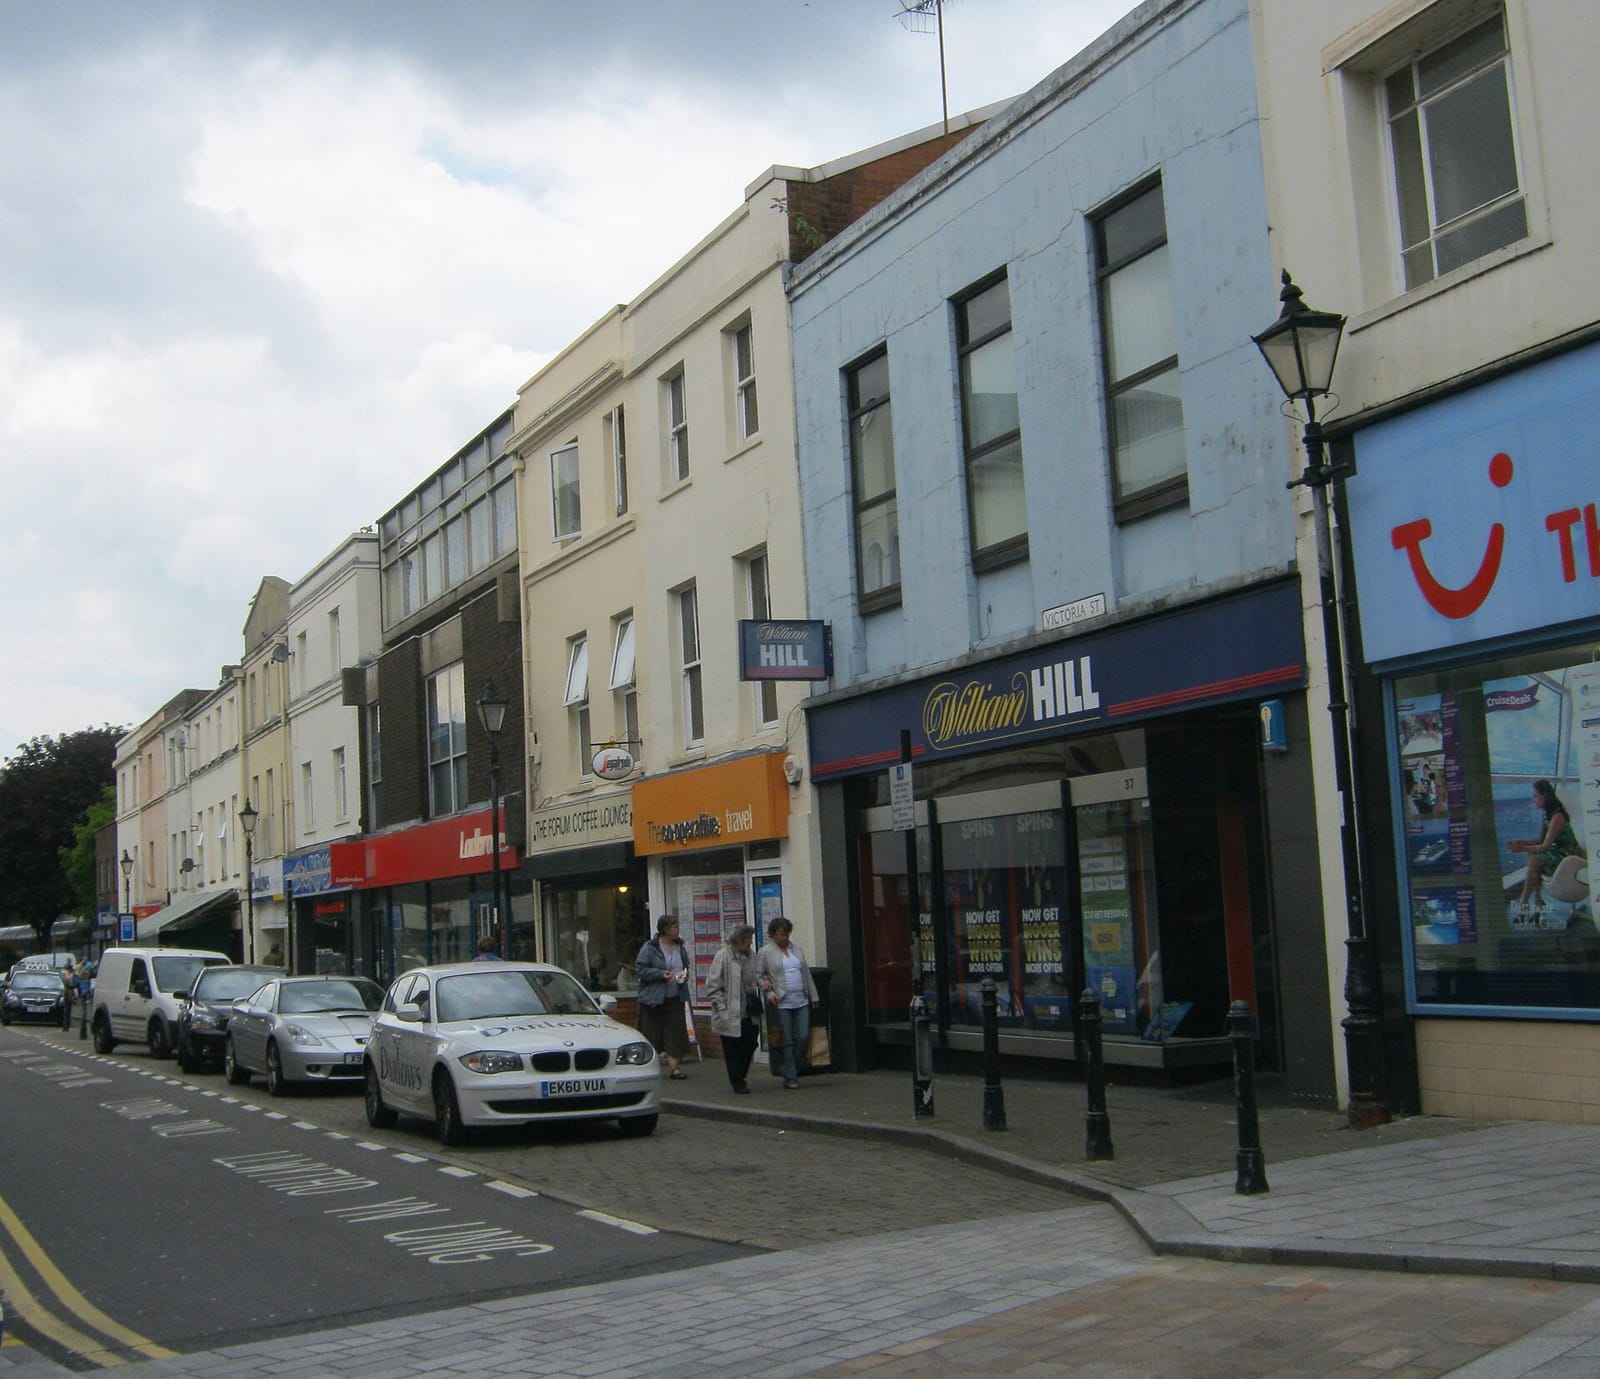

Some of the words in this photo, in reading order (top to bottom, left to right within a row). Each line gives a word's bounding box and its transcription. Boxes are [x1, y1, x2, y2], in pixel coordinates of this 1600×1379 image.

[1045, 604, 1087, 626] VICTORIA
[1089, 599, 1101, 614] ST
[756, 622, 810, 642] William
[760, 644, 809, 667] HILL
[923, 671, 1030, 749] William
[1029, 655, 1100, 721] HILL
[1123, 779, 1135, 791] 37
[535, 820, 547, 839] THE
[547, 815, 571, 837] FORUM
[572, 809, 598, 832] COFFEE
[600, 803, 628, 828] LOUNGE
[726, 802, 753, 833] travel
[1016, 811, 1054, 833] SPINS
[960, 819, 995, 840] SPINS
[966, 911, 985, 924] NOW
[985, 909, 1000, 923] GET
[1022, 908, 1041, 922] NOW
[1042, 907, 1059, 921] GET
[967, 924, 1001, 940] BIGGER
[1023, 922, 1061, 939] BIGGER
[968, 940, 1002, 962] WINS
[1024, 940, 1063, 962] WINS
[969, 962, 986, 973] MORE
[1025, 963, 1043, 973] MORE
[1044, 962, 1063, 973] OFTEN
[549, 1080, 581, 1095] EK60
[583, 1079, 607, 1093] VUA
